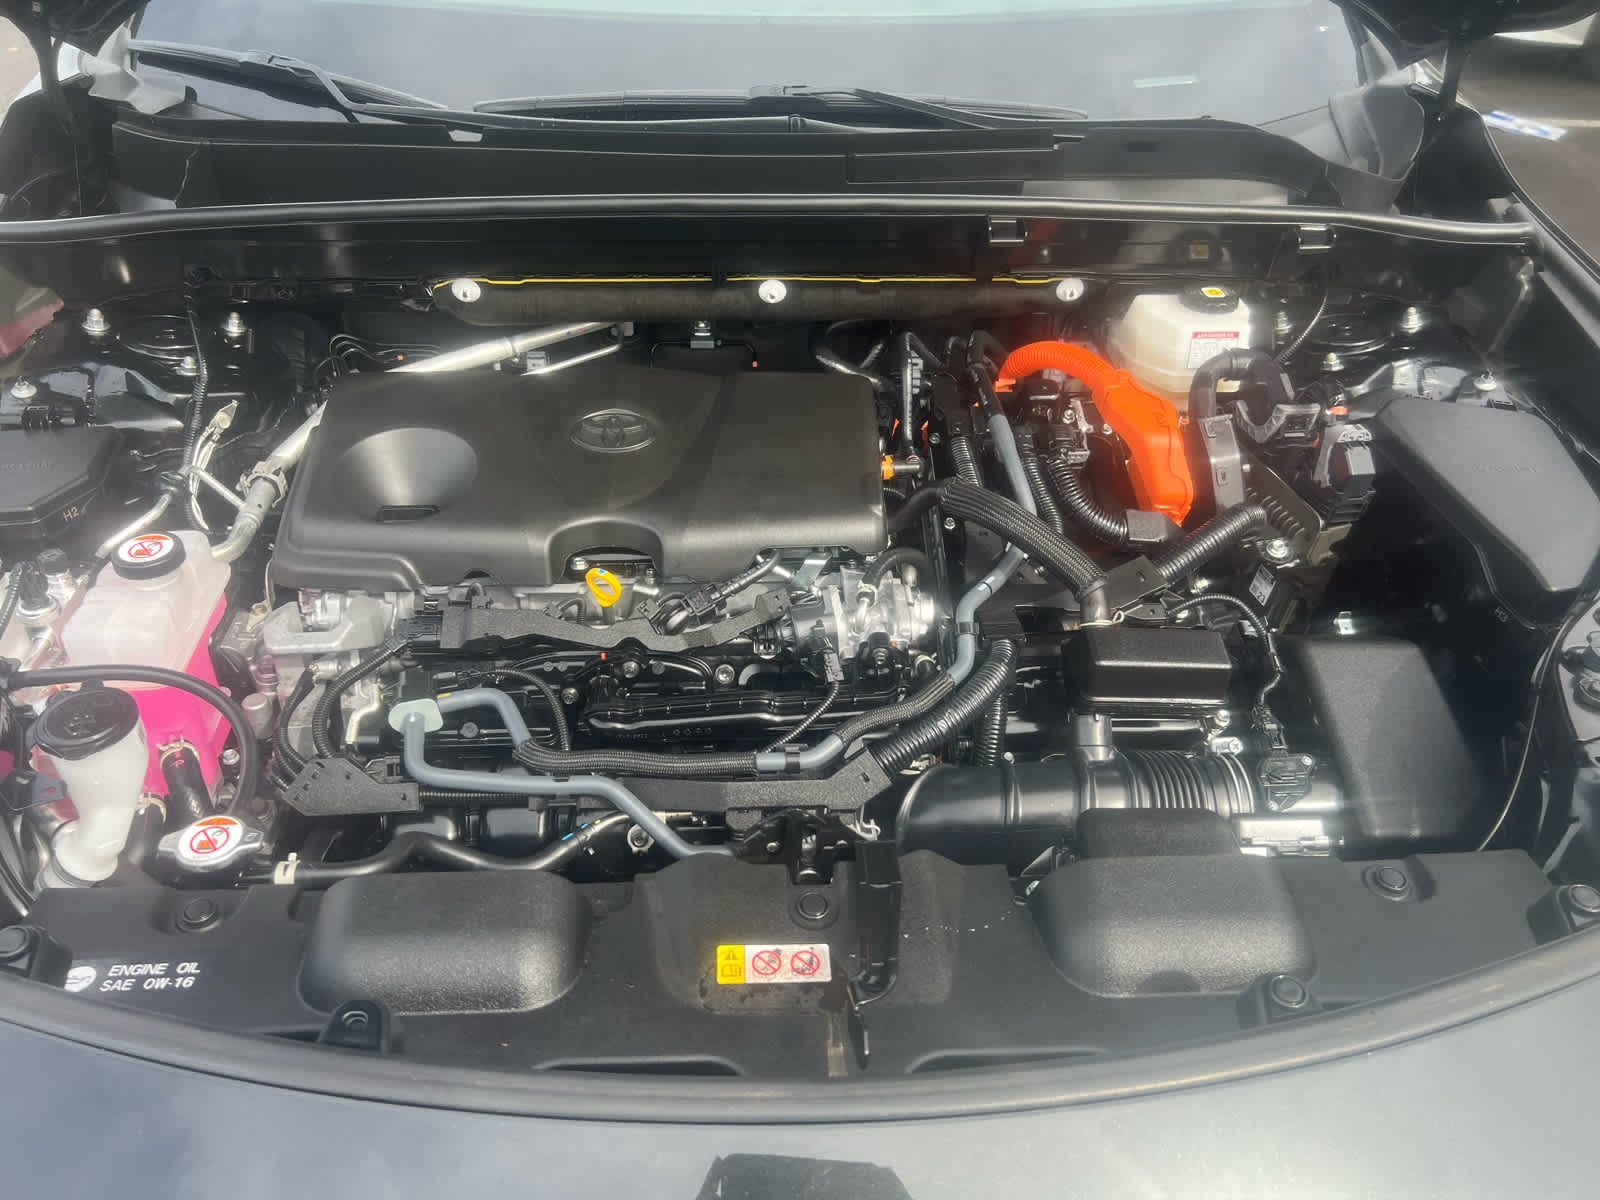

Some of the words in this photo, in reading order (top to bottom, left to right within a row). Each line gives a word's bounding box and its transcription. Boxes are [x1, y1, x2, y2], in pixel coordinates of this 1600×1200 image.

[107, 963, 169, 977] ENGINE
[175, 961, 201, 974] OIL
[99, 979, 137, 992] SAE
[142, 976, 196, 990] 0W-16
